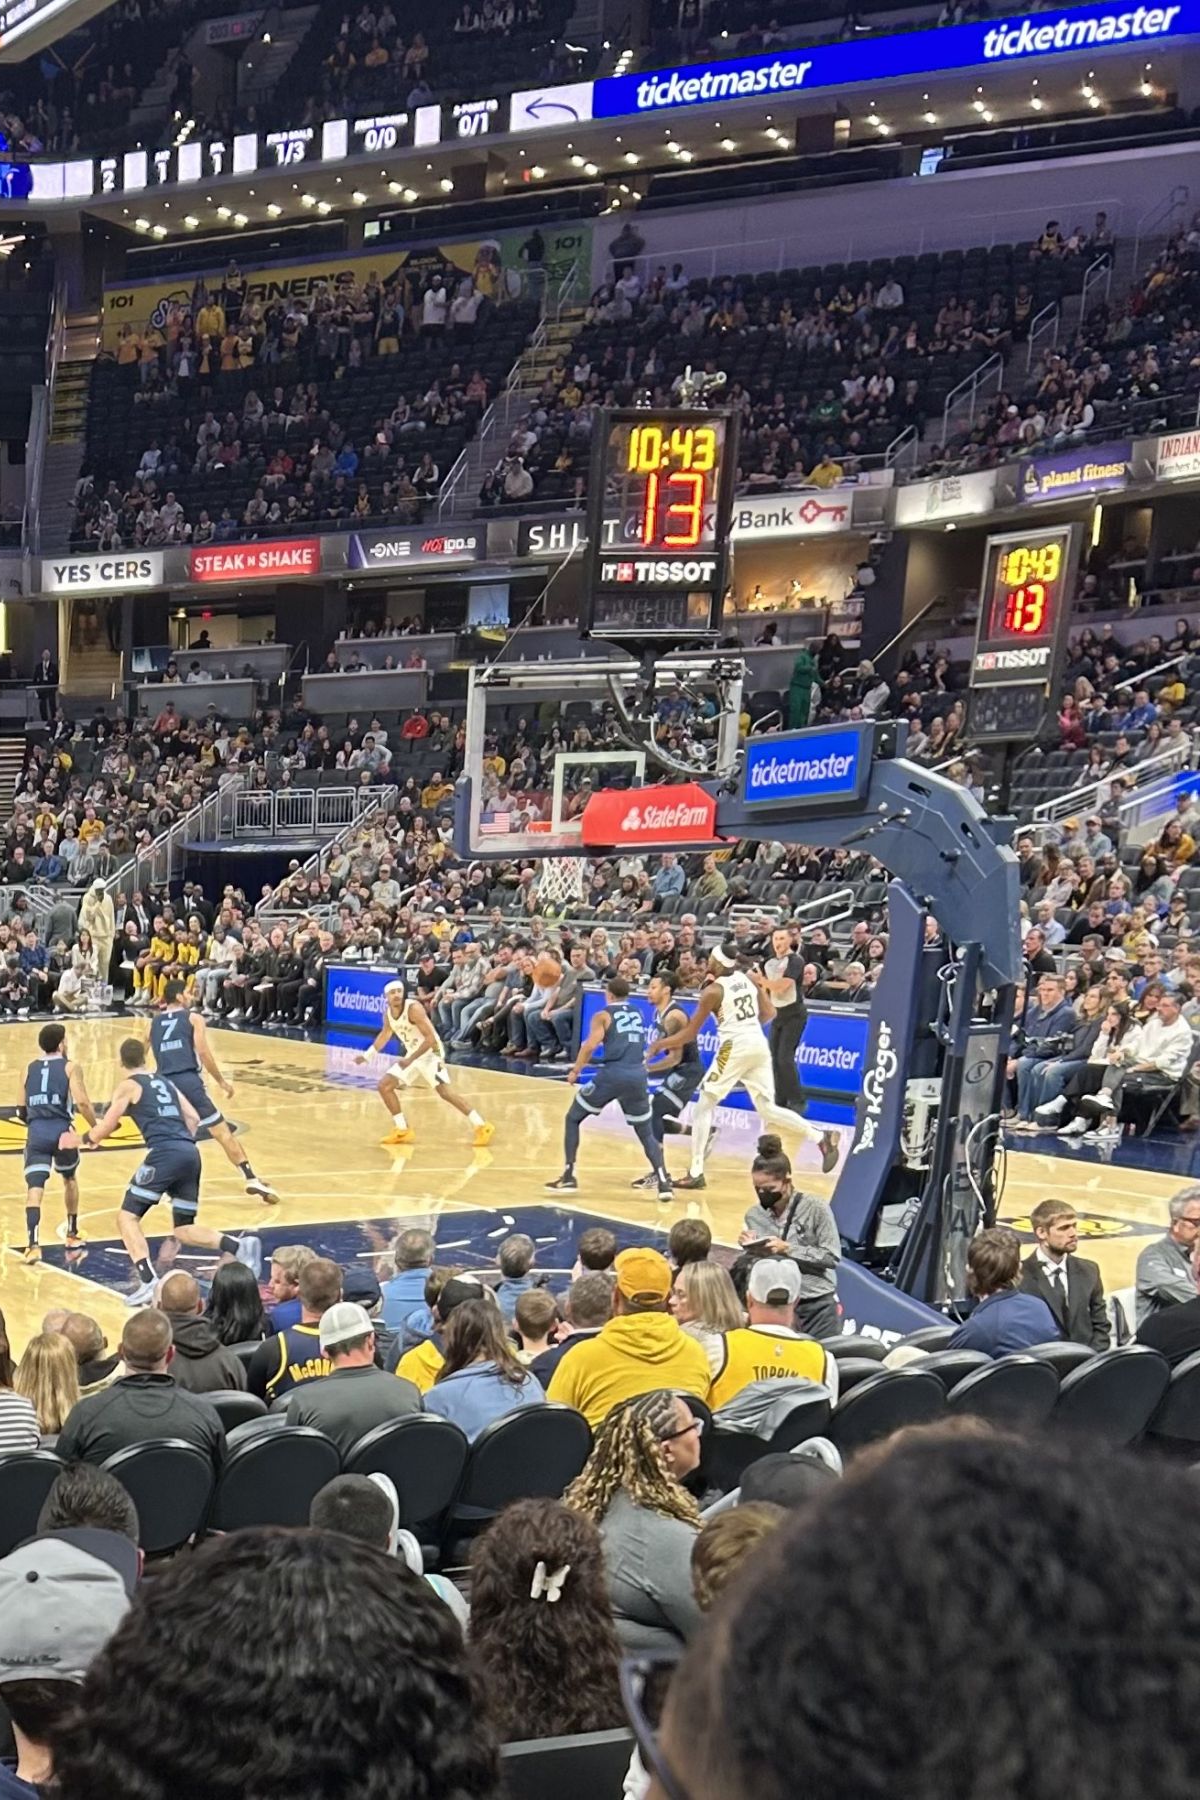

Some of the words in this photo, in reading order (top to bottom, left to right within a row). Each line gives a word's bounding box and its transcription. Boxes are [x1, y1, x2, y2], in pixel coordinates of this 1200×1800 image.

[983, 1, 1181, 59] ticketmaster
[636, 57, 812, 110] ticketmaster
[457, 113, 490, 137] 0/1
[364, 127, 397, 150] 0/0
[275, 142, 305, 166] 1/3
[555, 236, 583, 249] 101
[110, 295, 134, 309] 101
[629, 427, 717, 472] 10:43
[1041, 467, 1081, 493] planet
[1082, 463, 1125, 481] fitness
[642, 472, 706, 547] 13
[53, 564, 92, 585] YES
[94, 560, 152, 581] 'CERS
[194, 553, 245, 573] STEAK
[258, 548, 313, 569] SHAKE
[634, 562, 717, 581] TISSOT
[1000, 544, 1061, 585] 10:43
[1006, 584, 1045, 633] 13
[996, 647, 1051, 669] TISSOT
[751, 753, 854, 788] ticketmaster
[734, 994, 756, 1021] 33
[161, 1018, 178, 1041] 7
[613, 1011, 645, 1034] 22
[863, 1020, 898, 1114] Kroger
[41, 1068, 49, 1092] 1
[150, 1080, 172, 1104] 3
